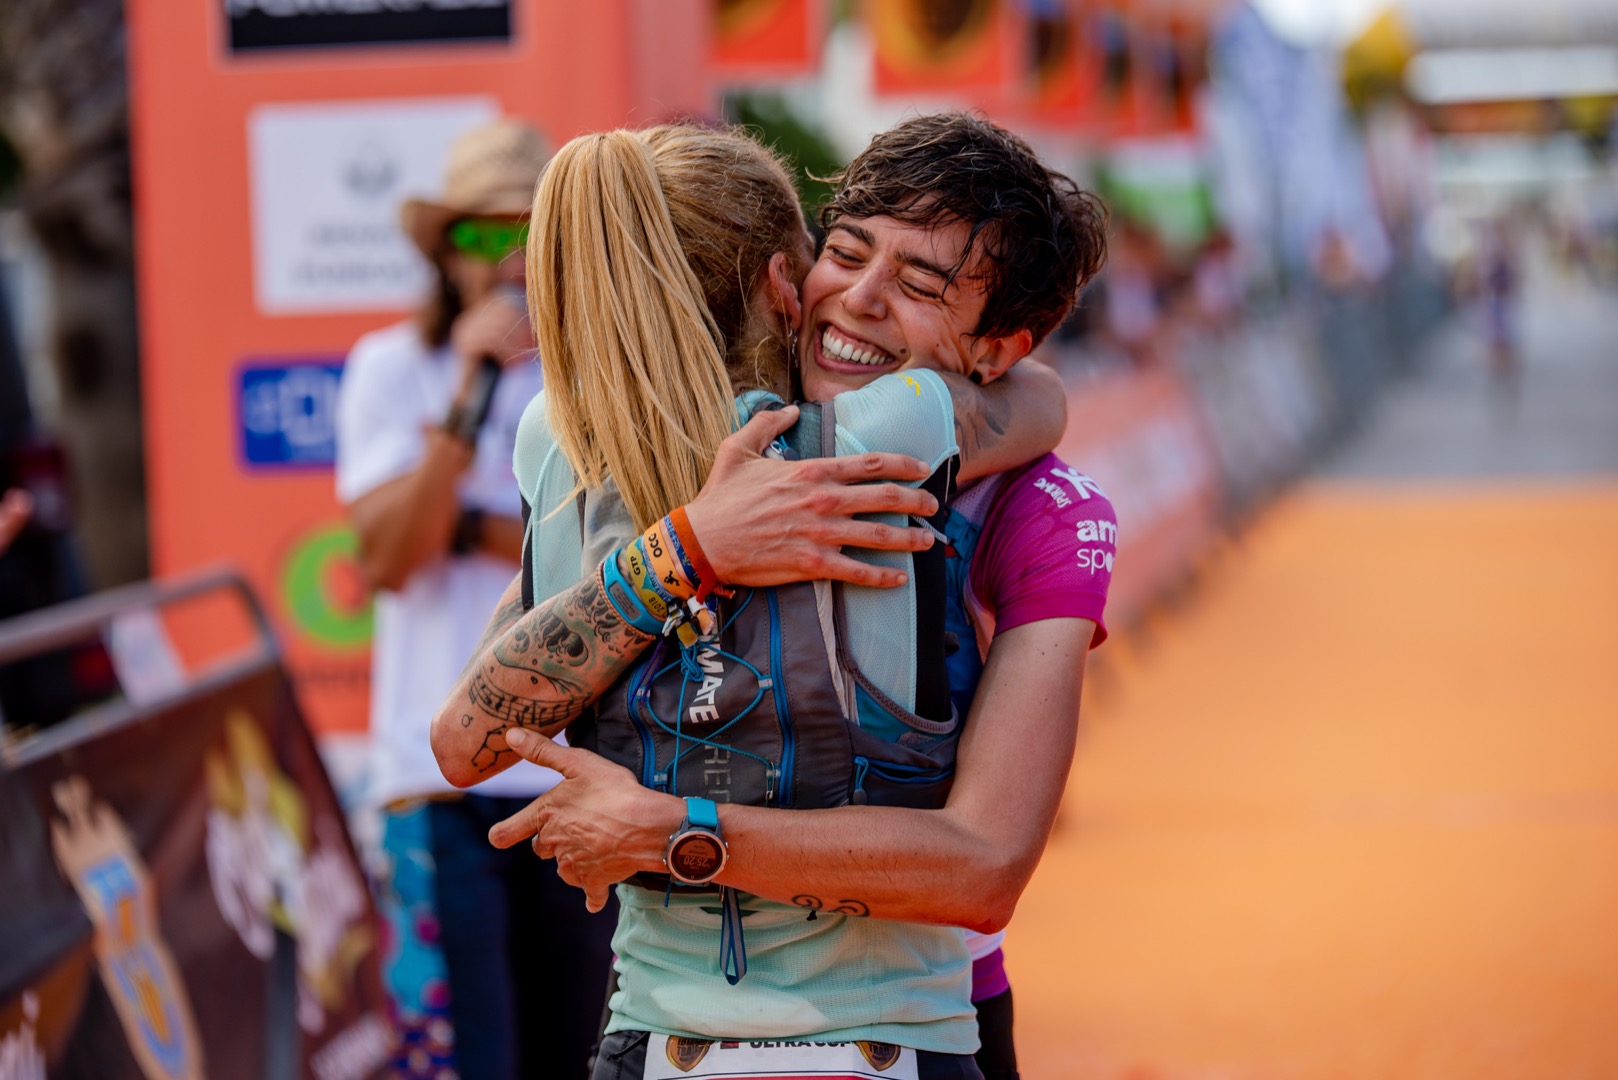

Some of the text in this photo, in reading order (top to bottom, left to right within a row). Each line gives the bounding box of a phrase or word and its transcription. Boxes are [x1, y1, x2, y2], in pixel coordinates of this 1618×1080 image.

[648, 532, 663, 558] OCC
[629, 555, 641, 576] GTP
[648, 595, 666, 614] 2018
